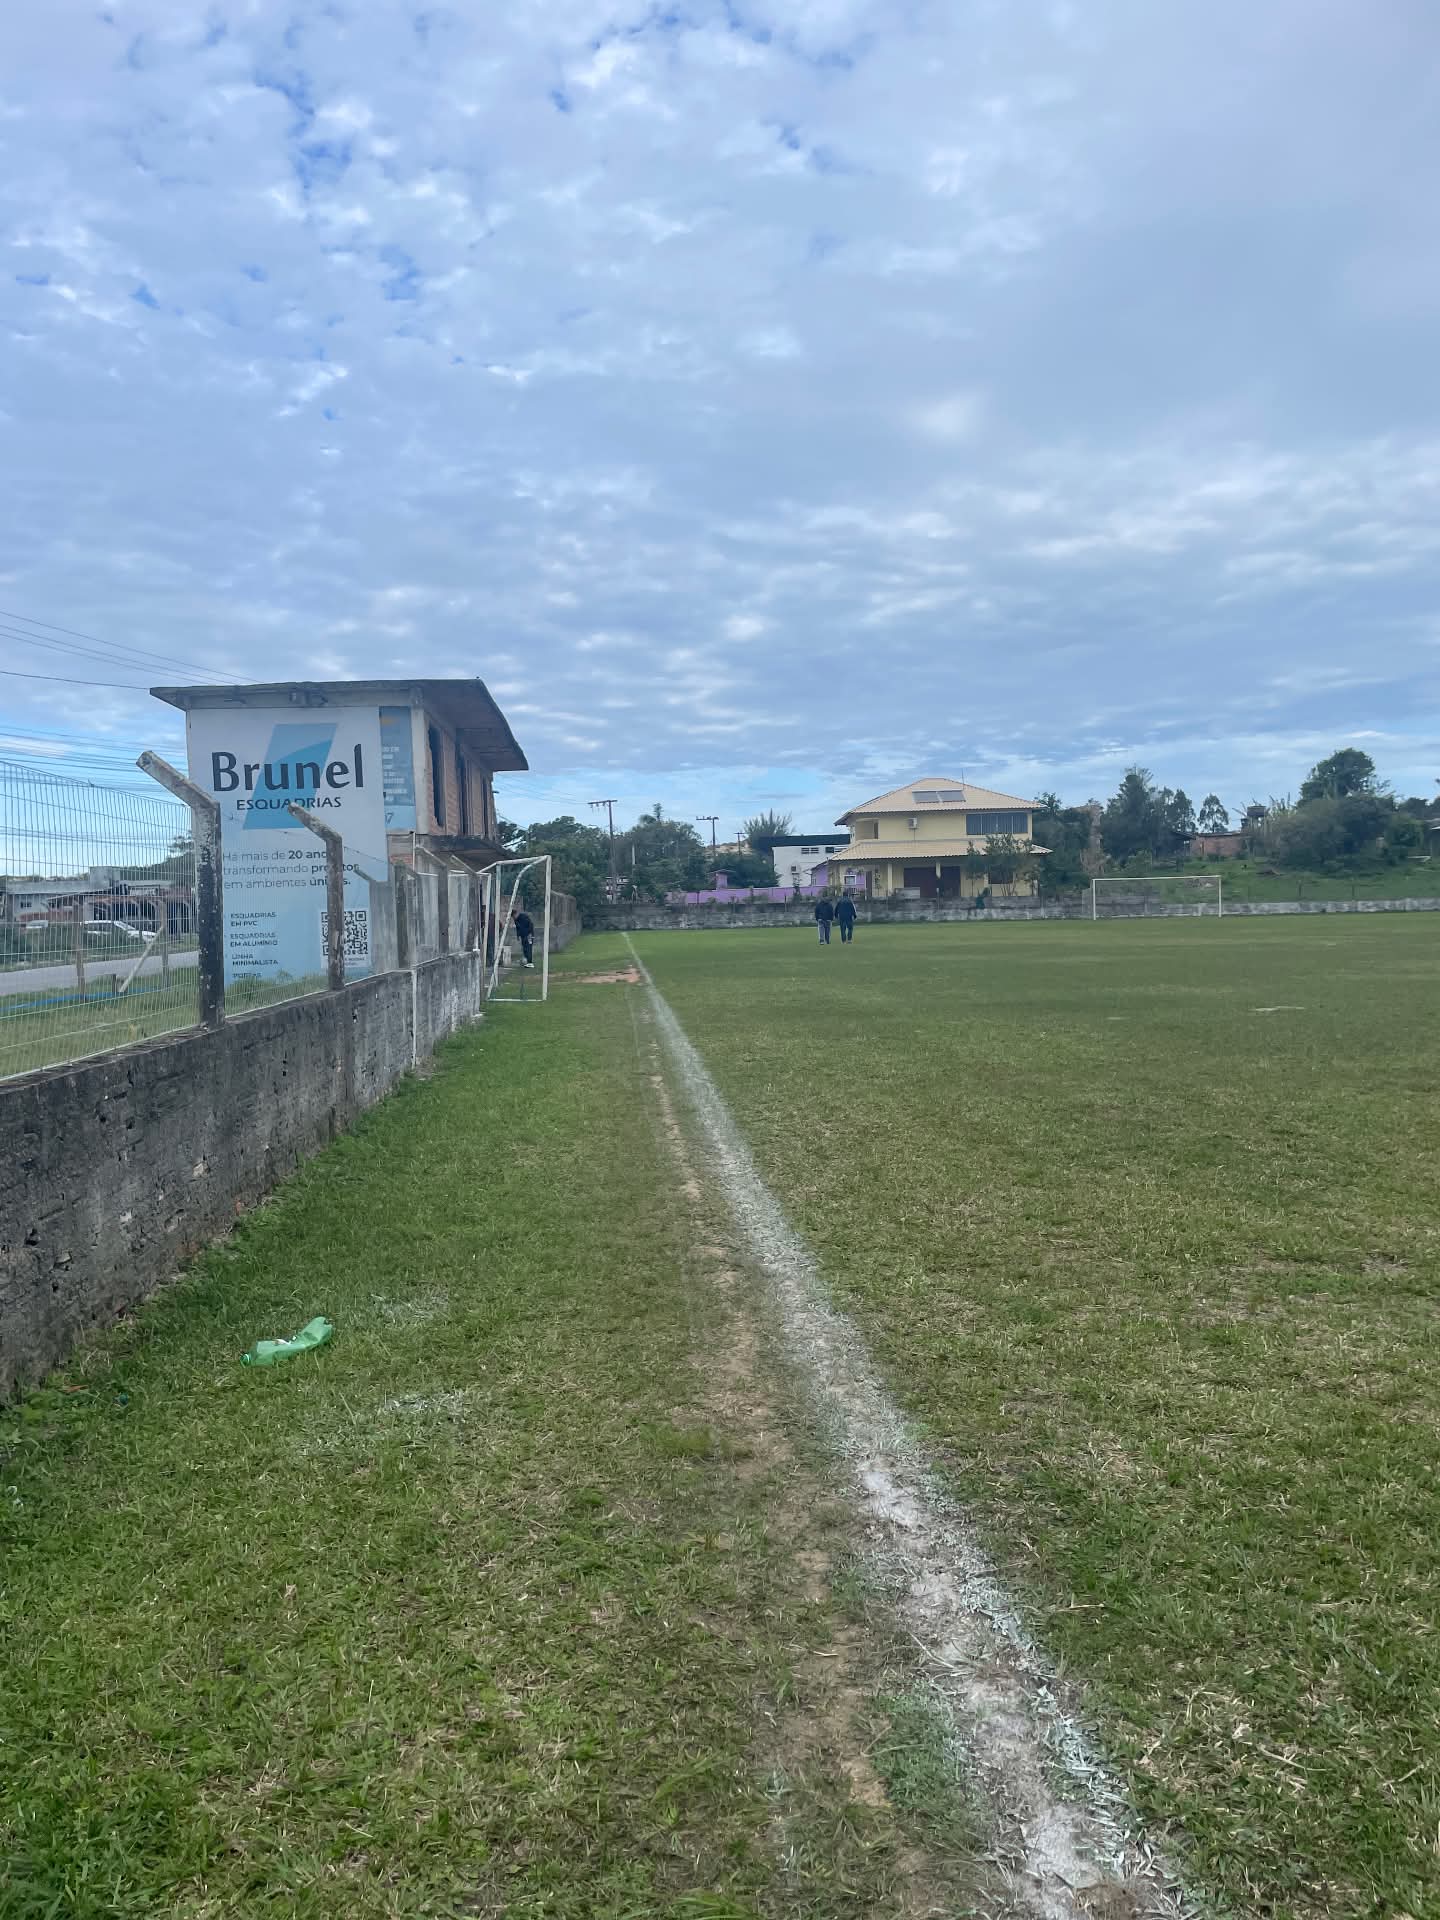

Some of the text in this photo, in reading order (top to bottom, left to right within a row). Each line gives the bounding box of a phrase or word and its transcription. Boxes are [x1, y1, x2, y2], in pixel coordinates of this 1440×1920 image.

[212, 744, 363, 791] Brunel
[236, 797, 342, 810] ESQUADRIAS
[242, 851, 269, 860] mais
[272, 850, 286, 860] de
[288, 850, 303, 859] 20
[306, 851, 328, 859] ano
[223, 864, 308, 875] transformando
[224, 881, 243, 889] em
[246, 879, 307, 888] ambientes
